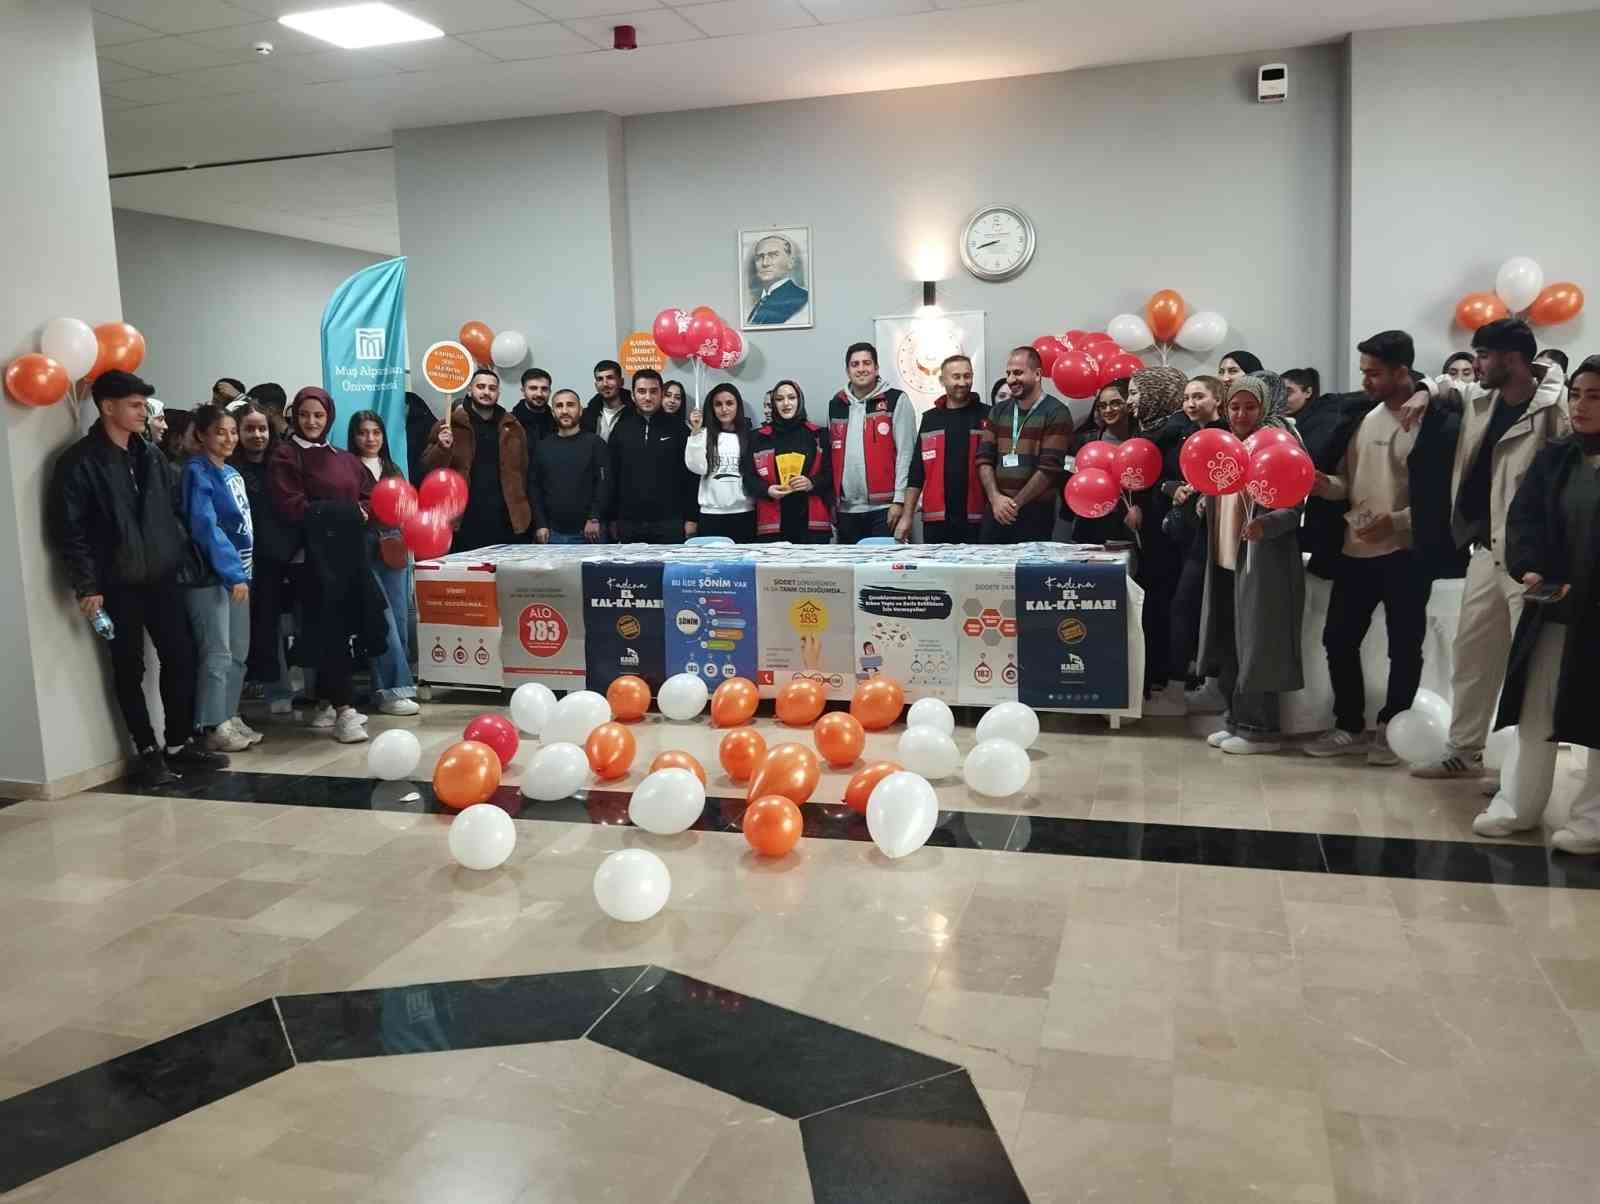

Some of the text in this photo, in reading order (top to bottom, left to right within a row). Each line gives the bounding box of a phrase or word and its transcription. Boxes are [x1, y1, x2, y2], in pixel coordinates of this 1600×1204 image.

[335, 366, 358, 378] Muş
[698, 576, 731, 589] ŞÖNİM
[621, 589, 634, 599] EL
[1062, 590, 1079, 600] EL
[1025, 600, 1117, 611] KAL-KA-MAZ!
[529, 607, 552, 619] ALO
[527, 620, 560, 641] 183
